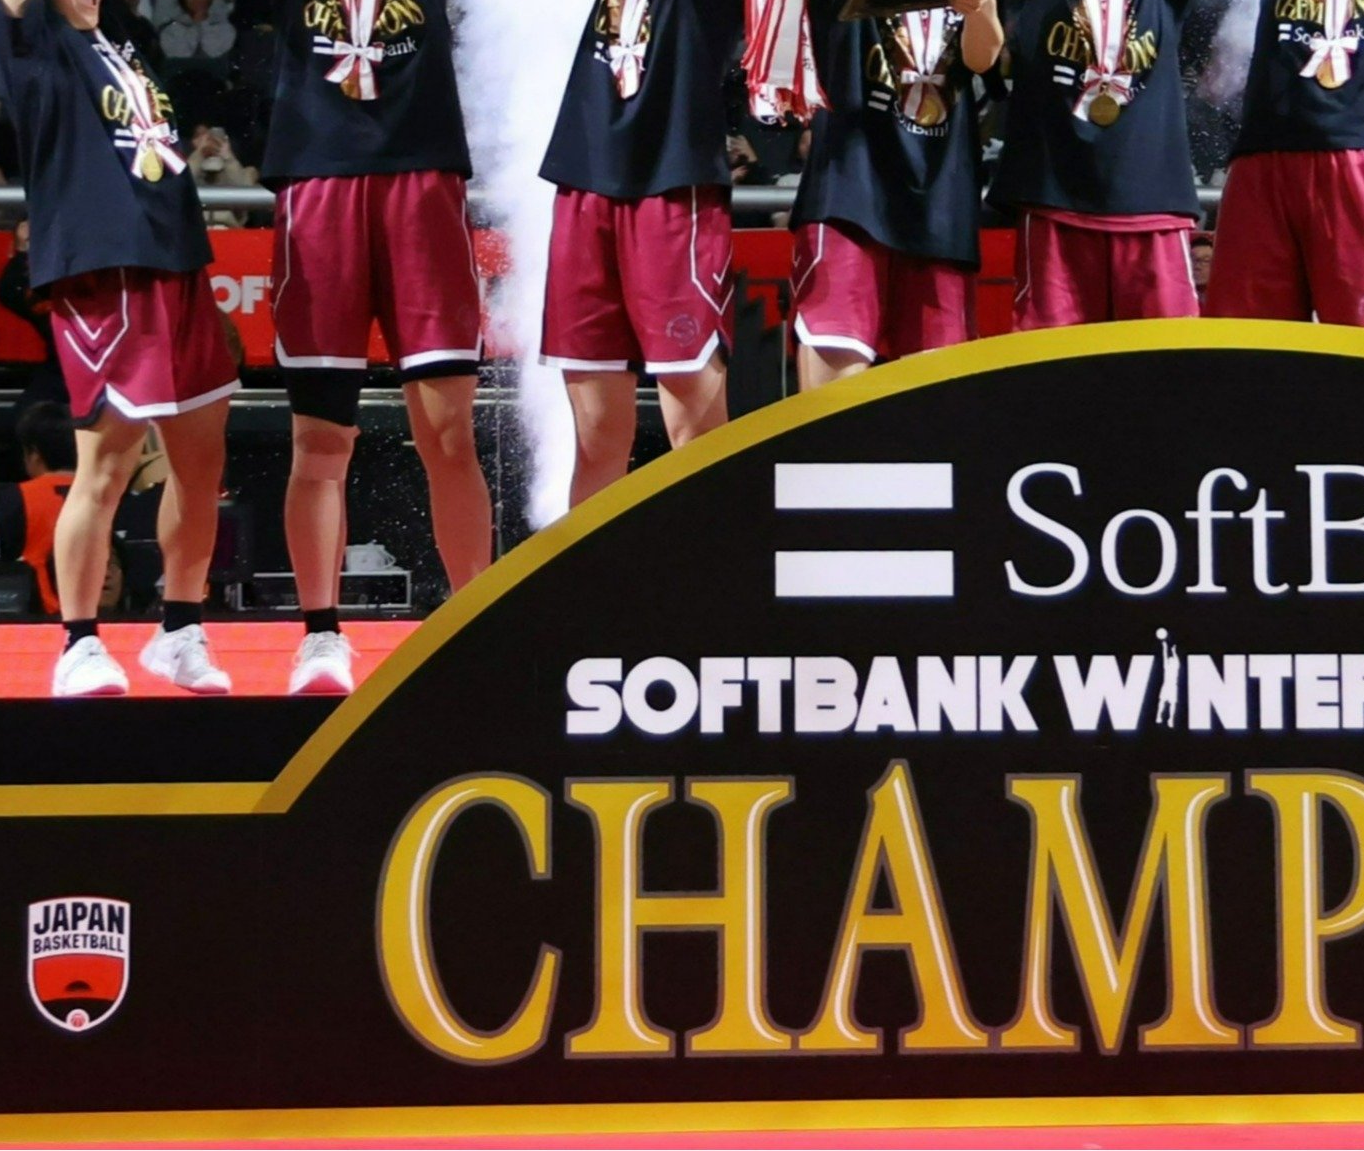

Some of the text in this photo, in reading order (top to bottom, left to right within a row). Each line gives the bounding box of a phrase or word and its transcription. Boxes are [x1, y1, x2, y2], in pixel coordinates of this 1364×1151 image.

[566, 655, 1039, 736] SOFTBANK
[33, 901, 125, 936] JAPAN
[32, 931, 124, 955] BASKETBALL
